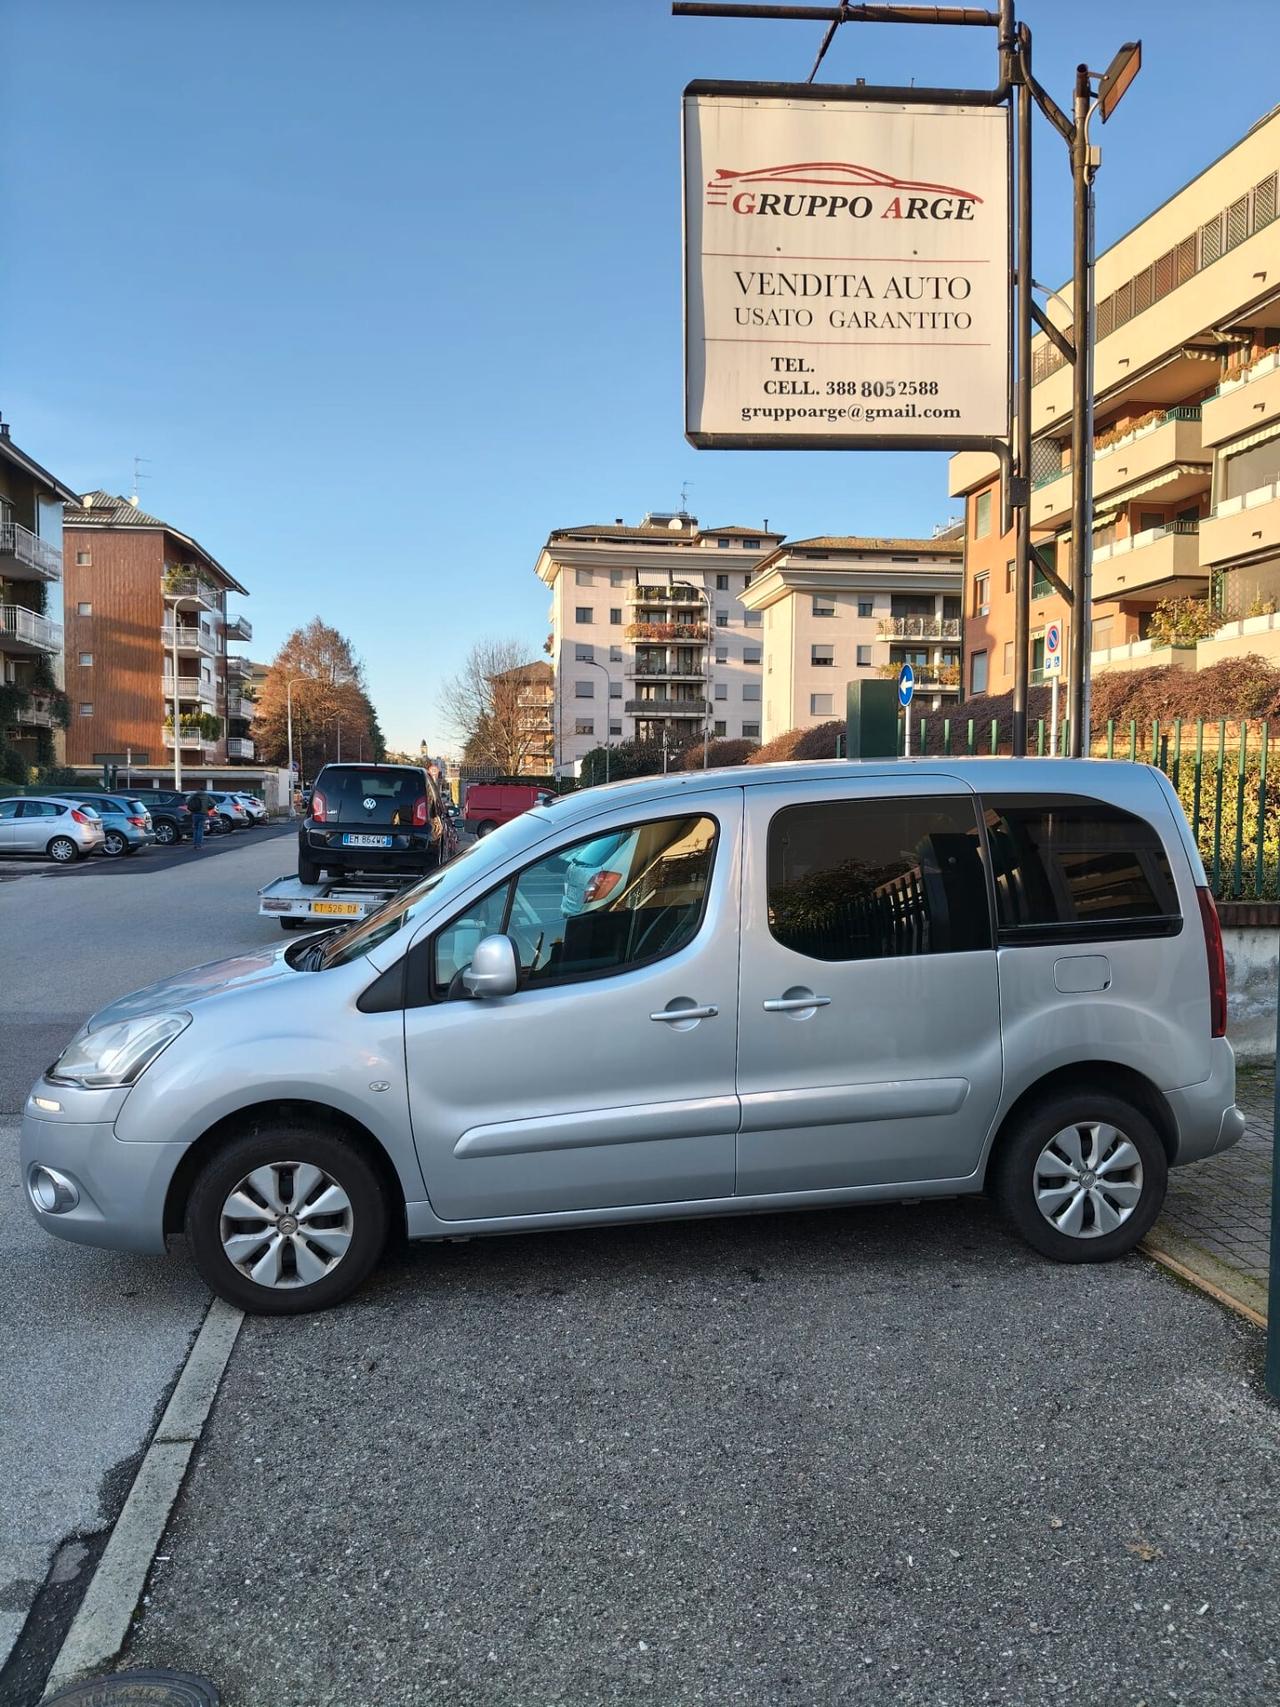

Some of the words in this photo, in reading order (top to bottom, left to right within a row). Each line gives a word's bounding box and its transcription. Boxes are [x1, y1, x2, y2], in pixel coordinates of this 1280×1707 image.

[733, 192, 872, 219] GRUPPO
[881, 196, 976, 221] ARGE
[733, 271, 874, 299] VENDITA
[882, 276, 972, 301] AUTO
[734, 307, 813, 327] USATO
[829, 311, 972, 330] GARANTITO
[771, 357, 815, 373] TEL.
[764, 381, 820, 396] CELL.
[826, 381, 857, 396] 388
[741, 404, 961, 423] gruppoarge@gmail.com
